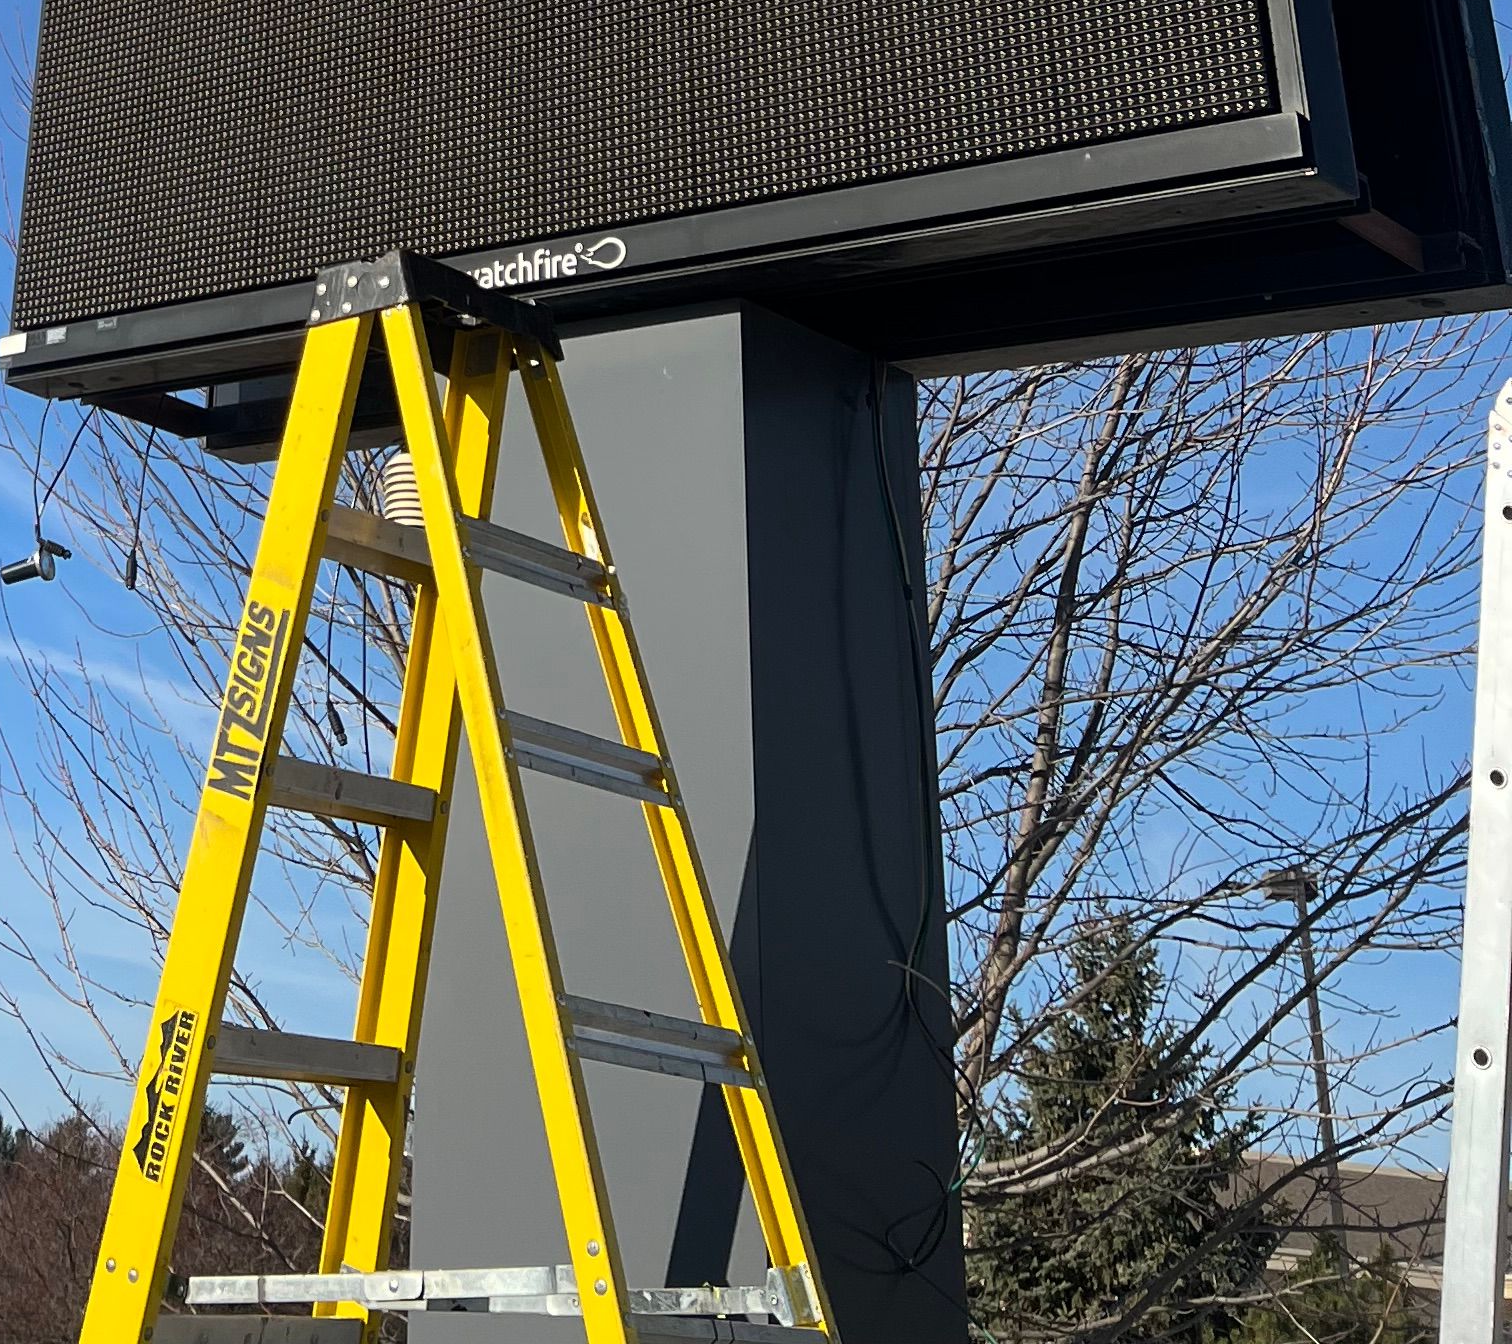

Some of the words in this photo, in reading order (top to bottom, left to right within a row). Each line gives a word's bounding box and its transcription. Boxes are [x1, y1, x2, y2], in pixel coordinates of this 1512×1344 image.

[228, 600, 277, 719] SIGNS
[144, 1100, 176, 1183] ROCK
[164, 1009, 196, 1097] RIVER
